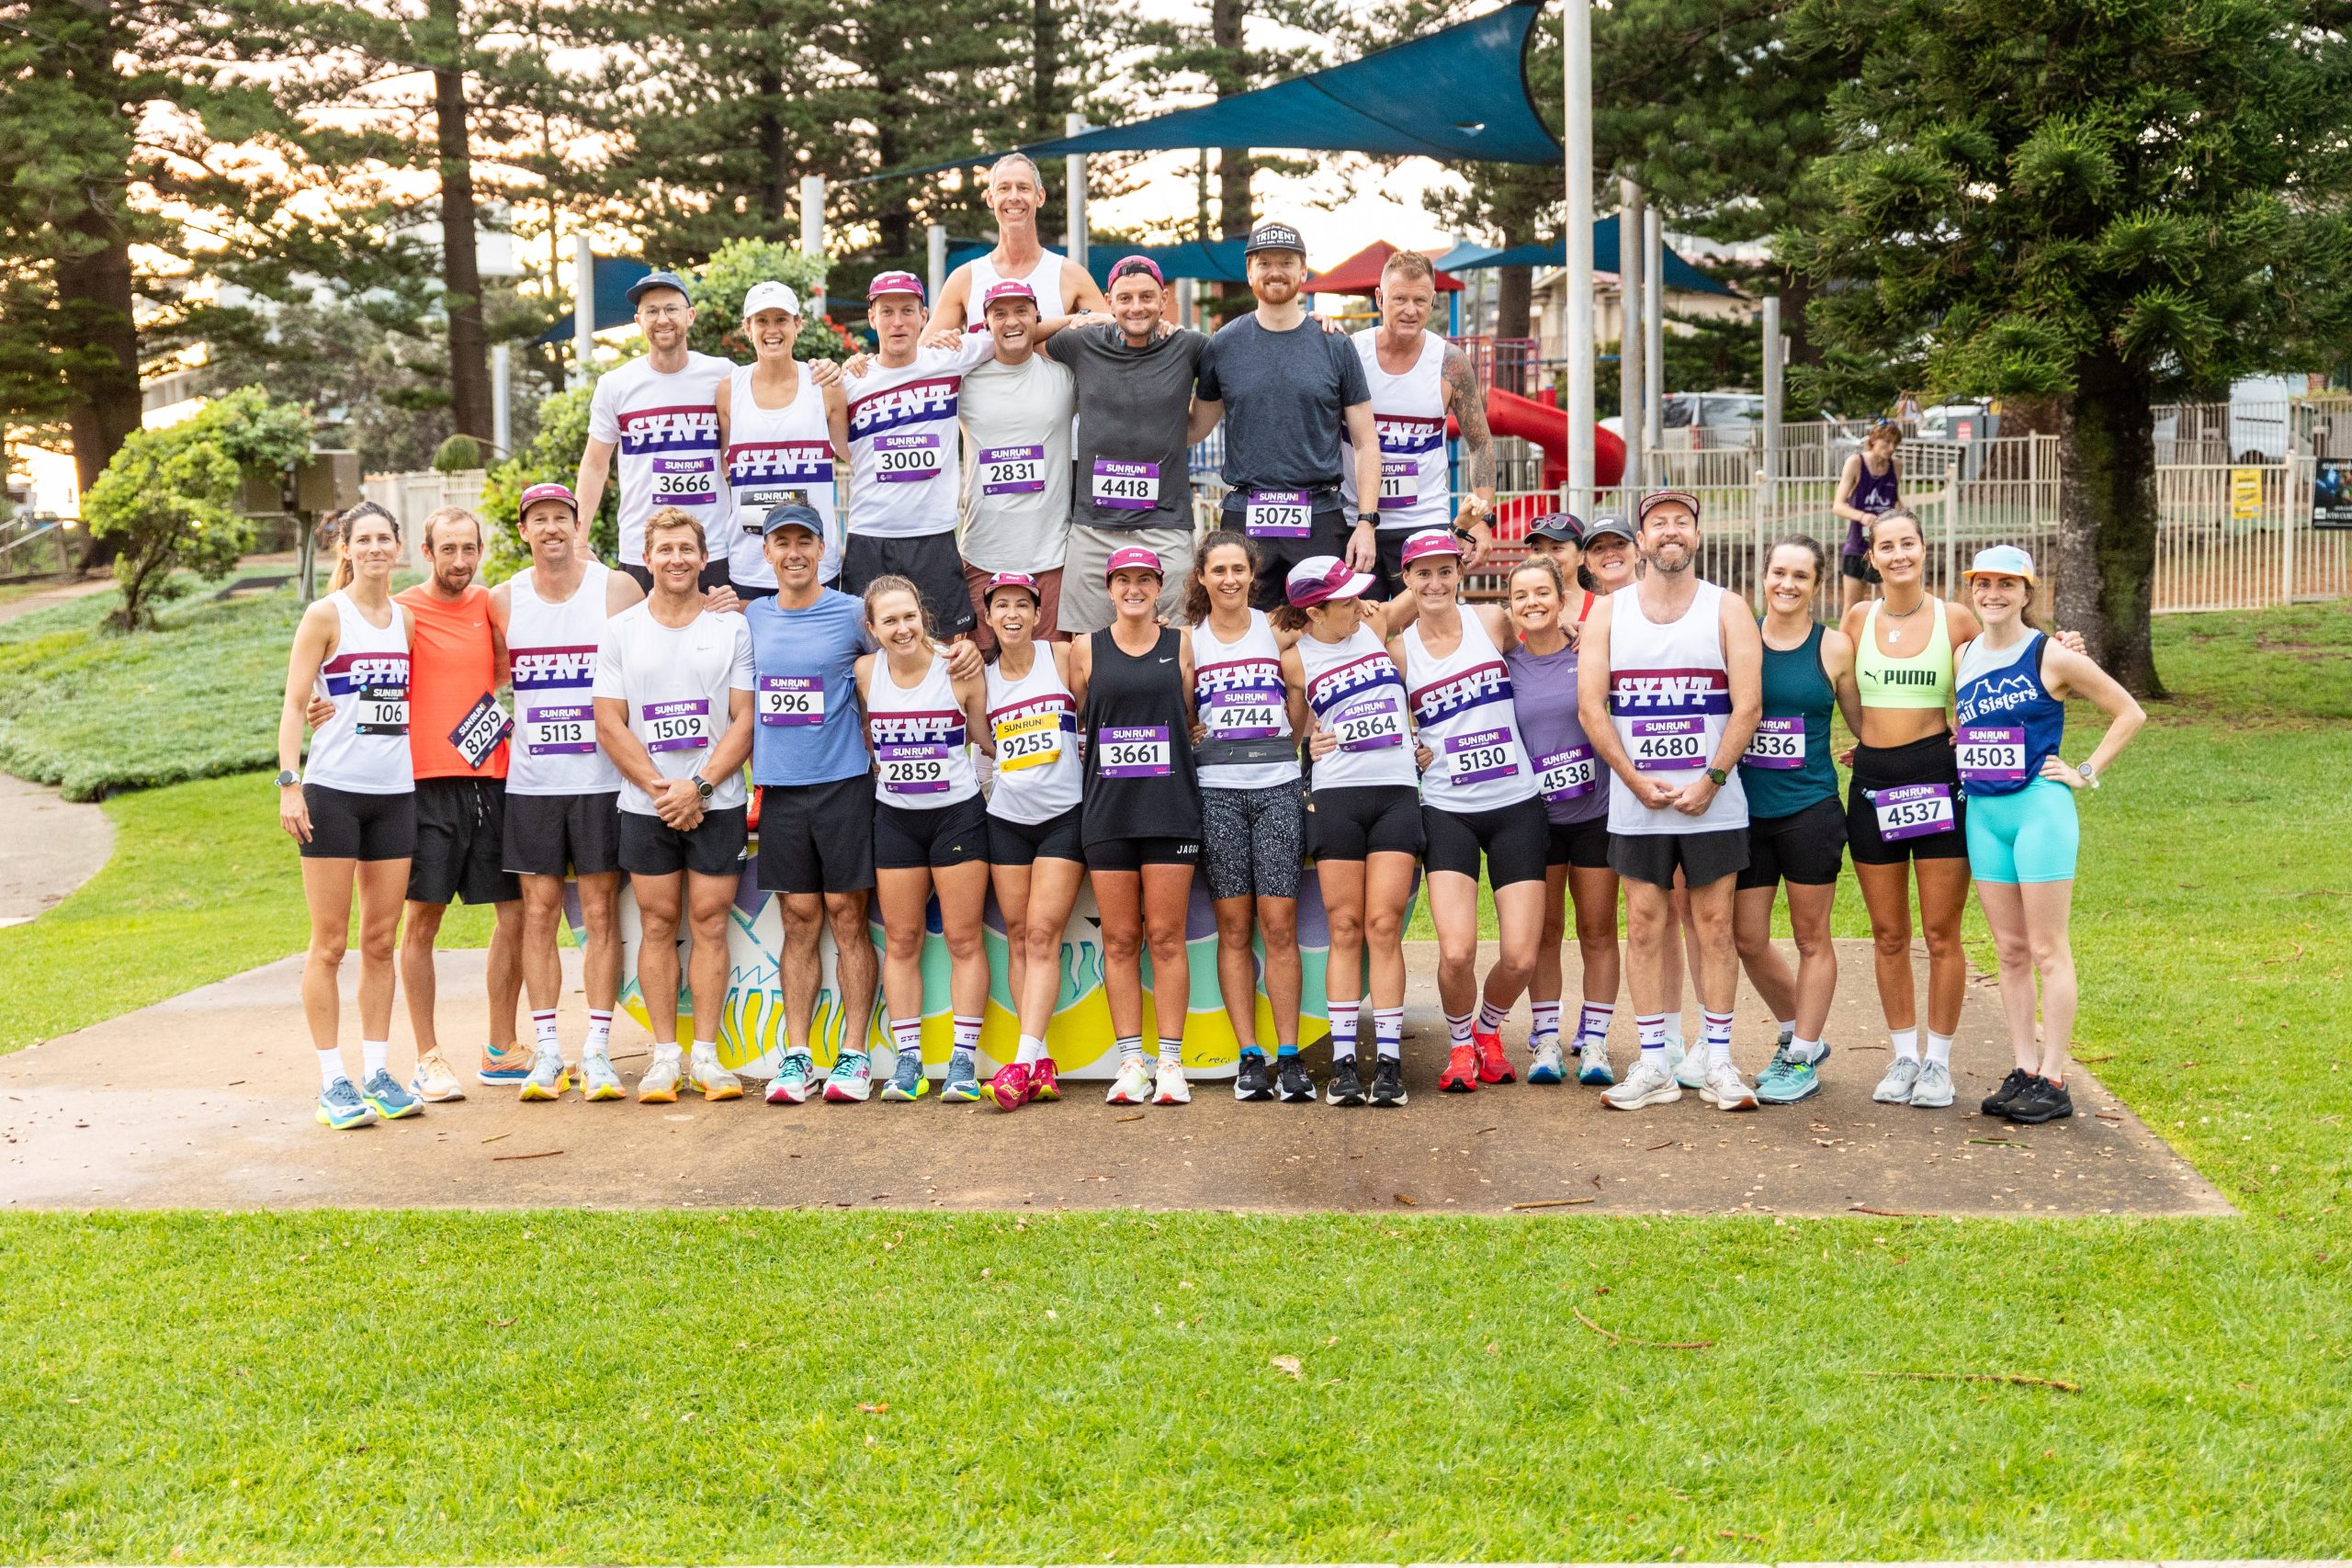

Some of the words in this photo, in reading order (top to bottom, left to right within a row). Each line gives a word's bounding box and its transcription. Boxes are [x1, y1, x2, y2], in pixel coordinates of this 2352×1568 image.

[1256, 230, 1296, 243] TRIDENT
[855, 384, 951, 430] SYNT
[628, 413, 719, 446] SYNT
[736, 447, 823, 478] SYNT
[882, 450, 935, 470] 3000
[990, 462, 1035, 482] 2831
[660, 474, 710, 493] 3666
[1101, 479, 1148, 498] 4418
[1254, 507, 1302, 525] 5075
[350, 659, 410, 685] SYN
[515, 652, 597, 682] SYNT
[1884, 671, 1937, 686] PUMA
[1197, 663, 1279, 697] SYNT
[1316, 656, 1394, 705] SYNT
[1618, 676, 1713, 707] SYNT
[771, 694, 809, 713] 996
[1420, 667, 1501, 719] SYNT
[375, 704, 402, 722] 106
[1220, 707, 1273, 727] 4744
[1959, 703, 1978, 725] ail
[1978, 688, 2039, 715] Sisters
[466, 710, 501, 755] 8299
[540, 724, 582, 742] 5113
[654, 717, 702, 740] 1509
[870, 716, 953, 743] SYNT
[1342, 715, 1396, 741] 2864
[1003, 731, 1054, 759] 9255
[1110, 744, 1159, 764] 3661
[1640, 736, 1699, 757] 4680
[1963, 748, 2016, 766] 4503
[888, 762, 942, 781] 2859
[1459, 747, 1506, 772] 5130
[1544, 762, 1589, 790] 4538
[1887, 800, 1941, 826] 4537
